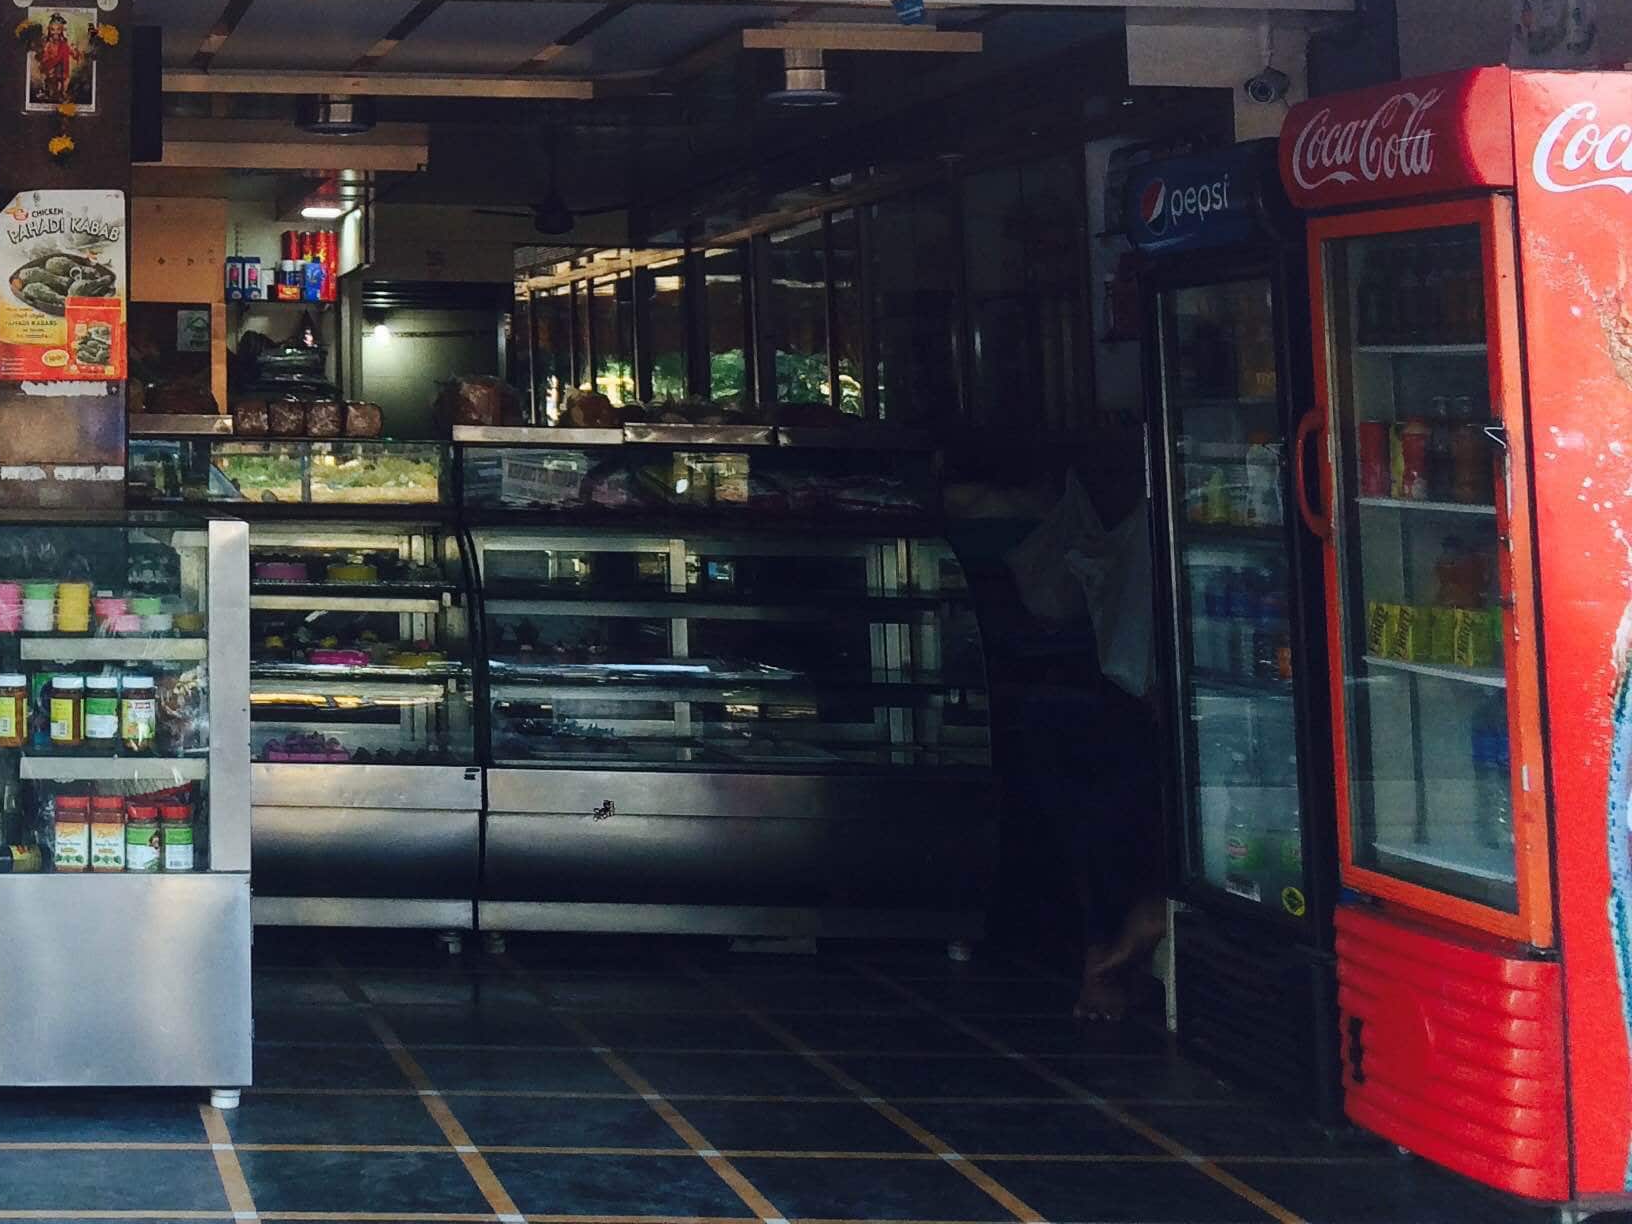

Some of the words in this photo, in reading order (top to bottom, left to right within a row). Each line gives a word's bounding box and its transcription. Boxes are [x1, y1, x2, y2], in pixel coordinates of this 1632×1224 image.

[1532, 101, 1632, 194] Coc
[32, 208, 64, 217] CHICKEN
[1171, 173, 1229, 226] pepsi
[7, 217, 65, 244] PAHADI
[70, 217, 120, 241] KABAB
